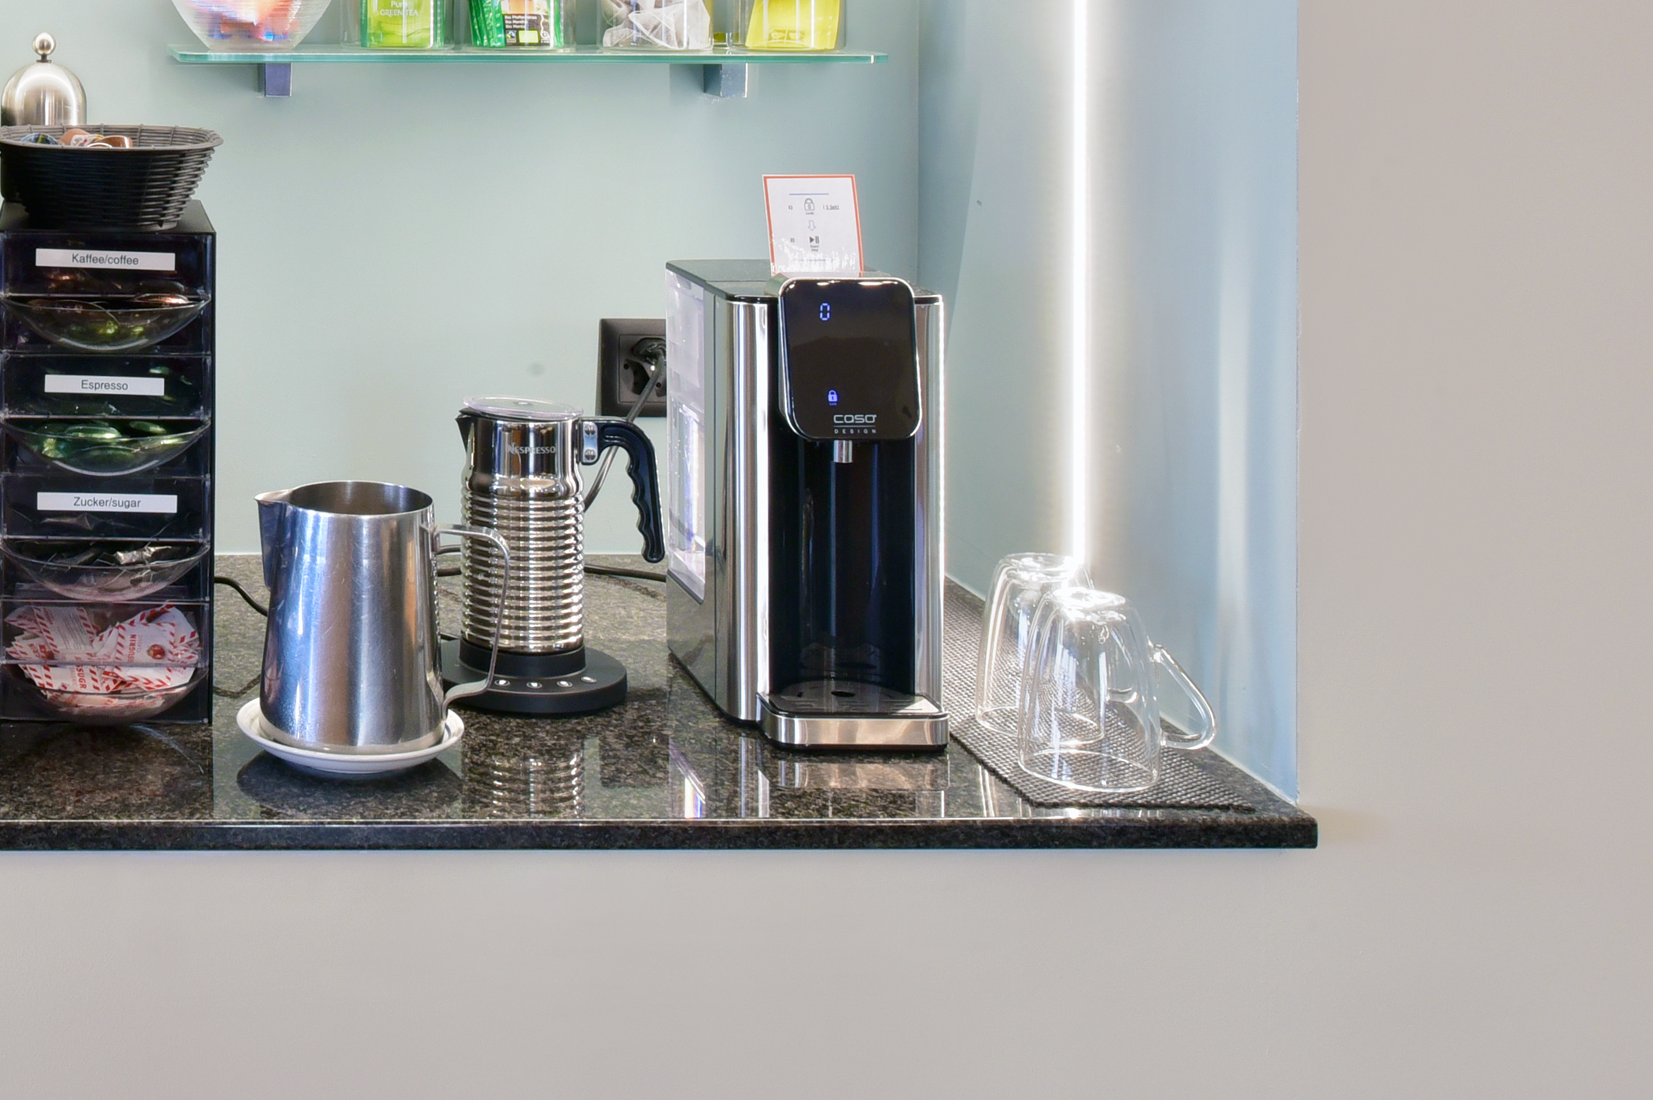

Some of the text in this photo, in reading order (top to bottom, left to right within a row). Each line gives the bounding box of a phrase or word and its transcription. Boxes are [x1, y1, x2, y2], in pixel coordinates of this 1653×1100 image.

[380, 9, 403, 17] GREEN
[71, 253, 139, 265] Kaffee/coffee
[820, 302, 830, 321] 0
[81, 379, 128, 391] Espresso
[507, 442, 556, 454] NESPRESSO
[73, 496, 141, 509] Zucker/sugar
